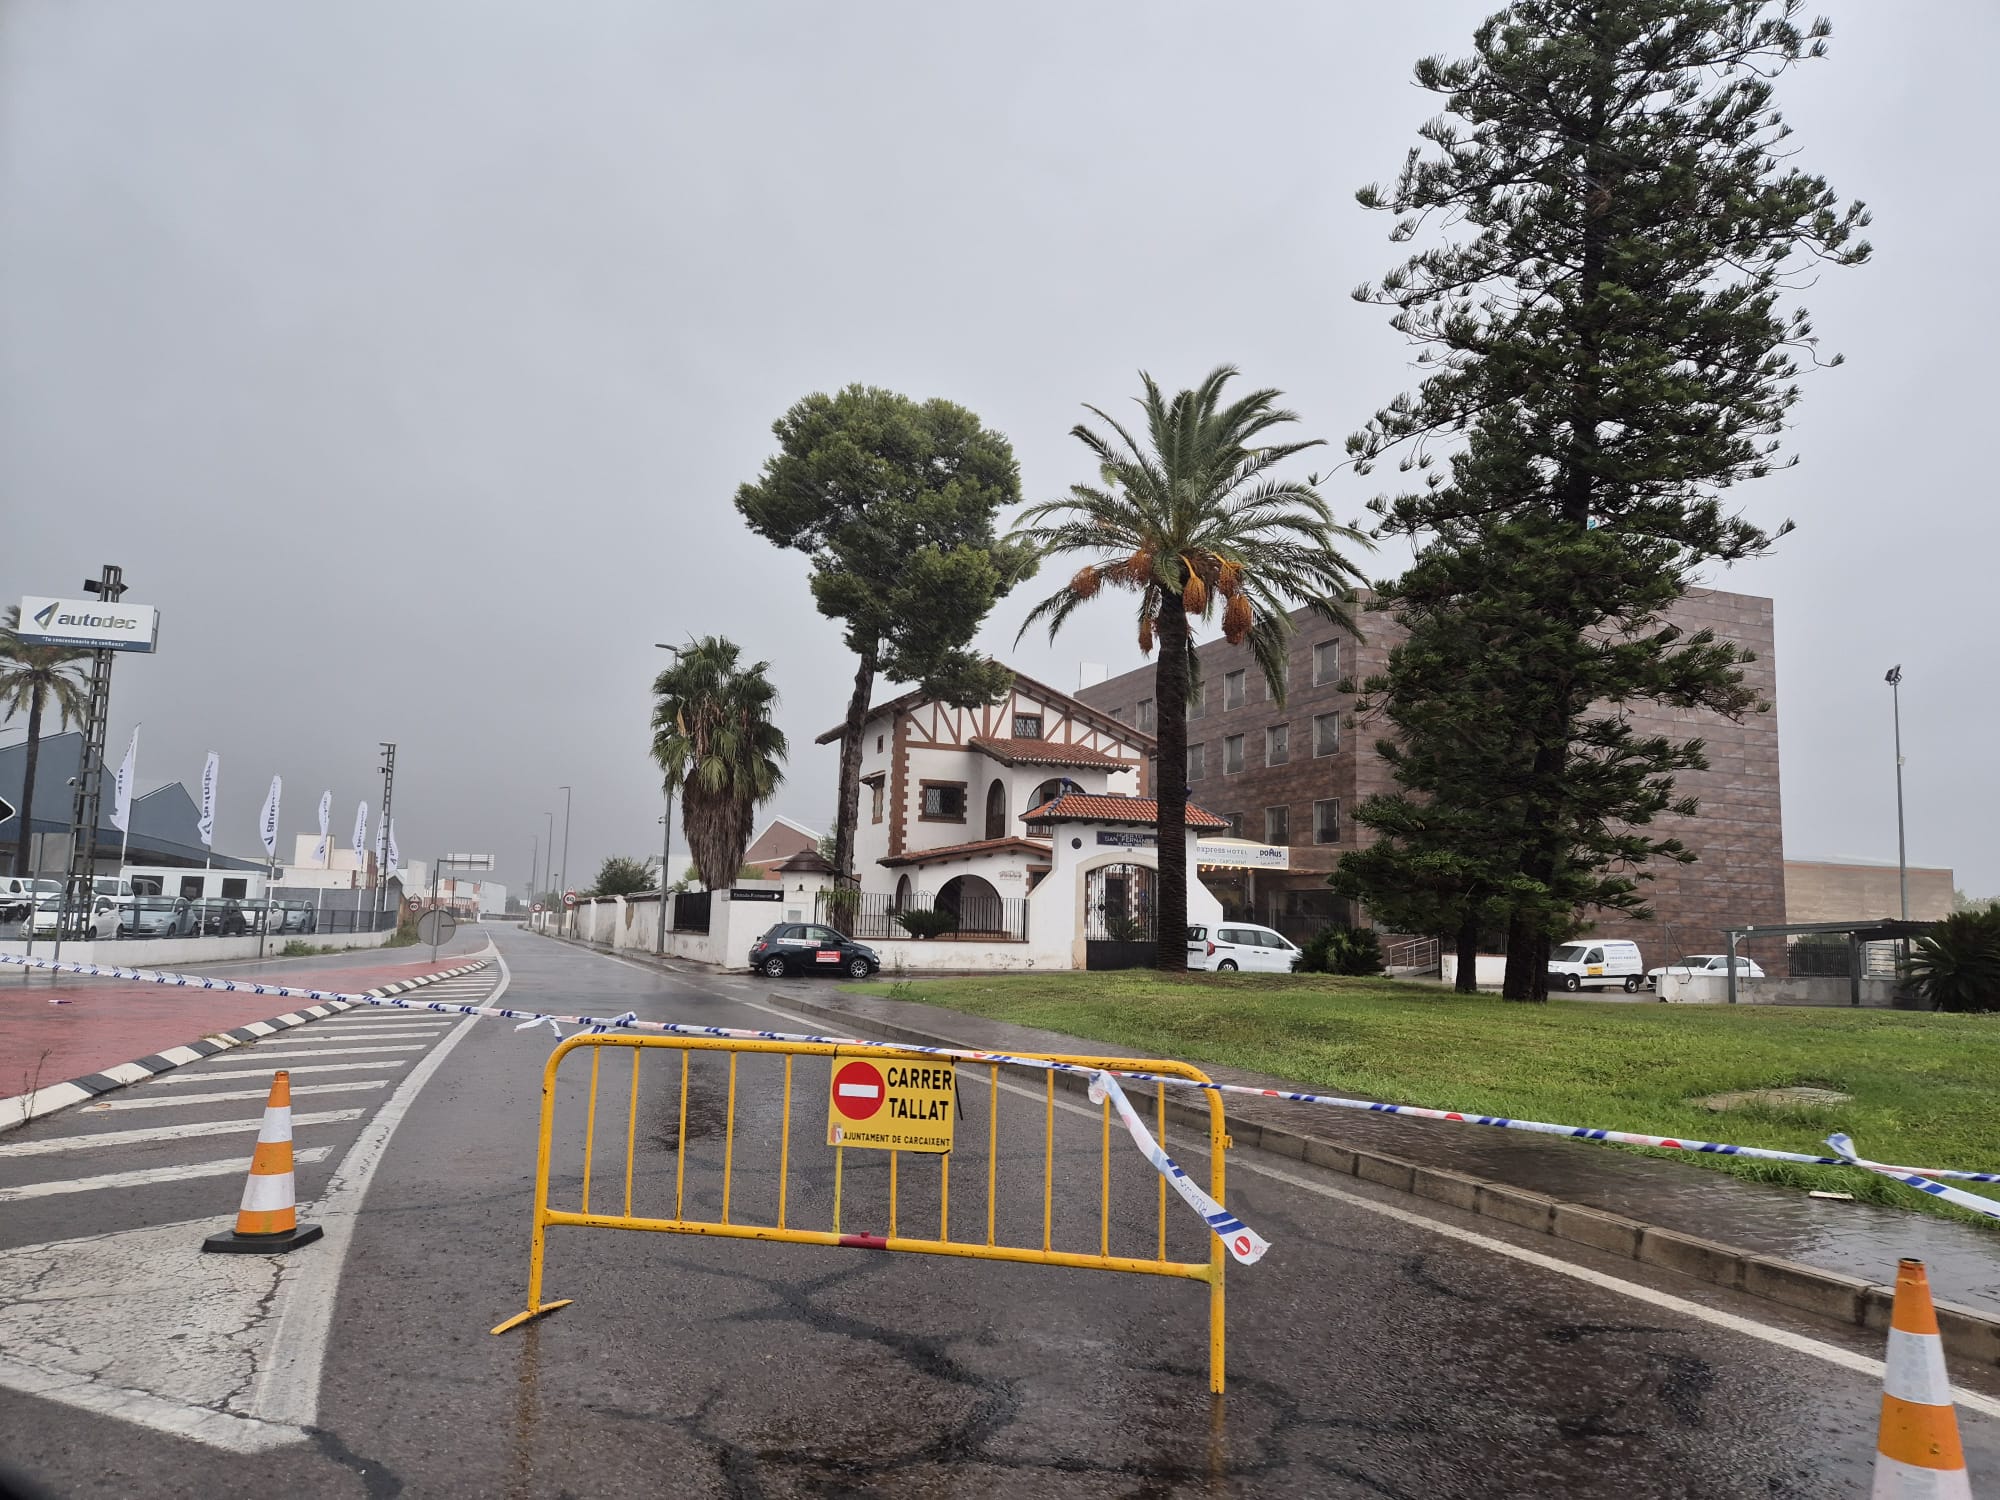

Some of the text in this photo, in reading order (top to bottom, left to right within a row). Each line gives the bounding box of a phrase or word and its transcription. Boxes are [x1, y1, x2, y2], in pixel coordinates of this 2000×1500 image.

[58, 614, 137, 630] autodec
[888, 1067, 952, 1090] CARRER
[889, 1098, 949, 1120] TALLAT
[844, 1132, 950, 1146] AJUNTAMENT DE CARCAIXENT
